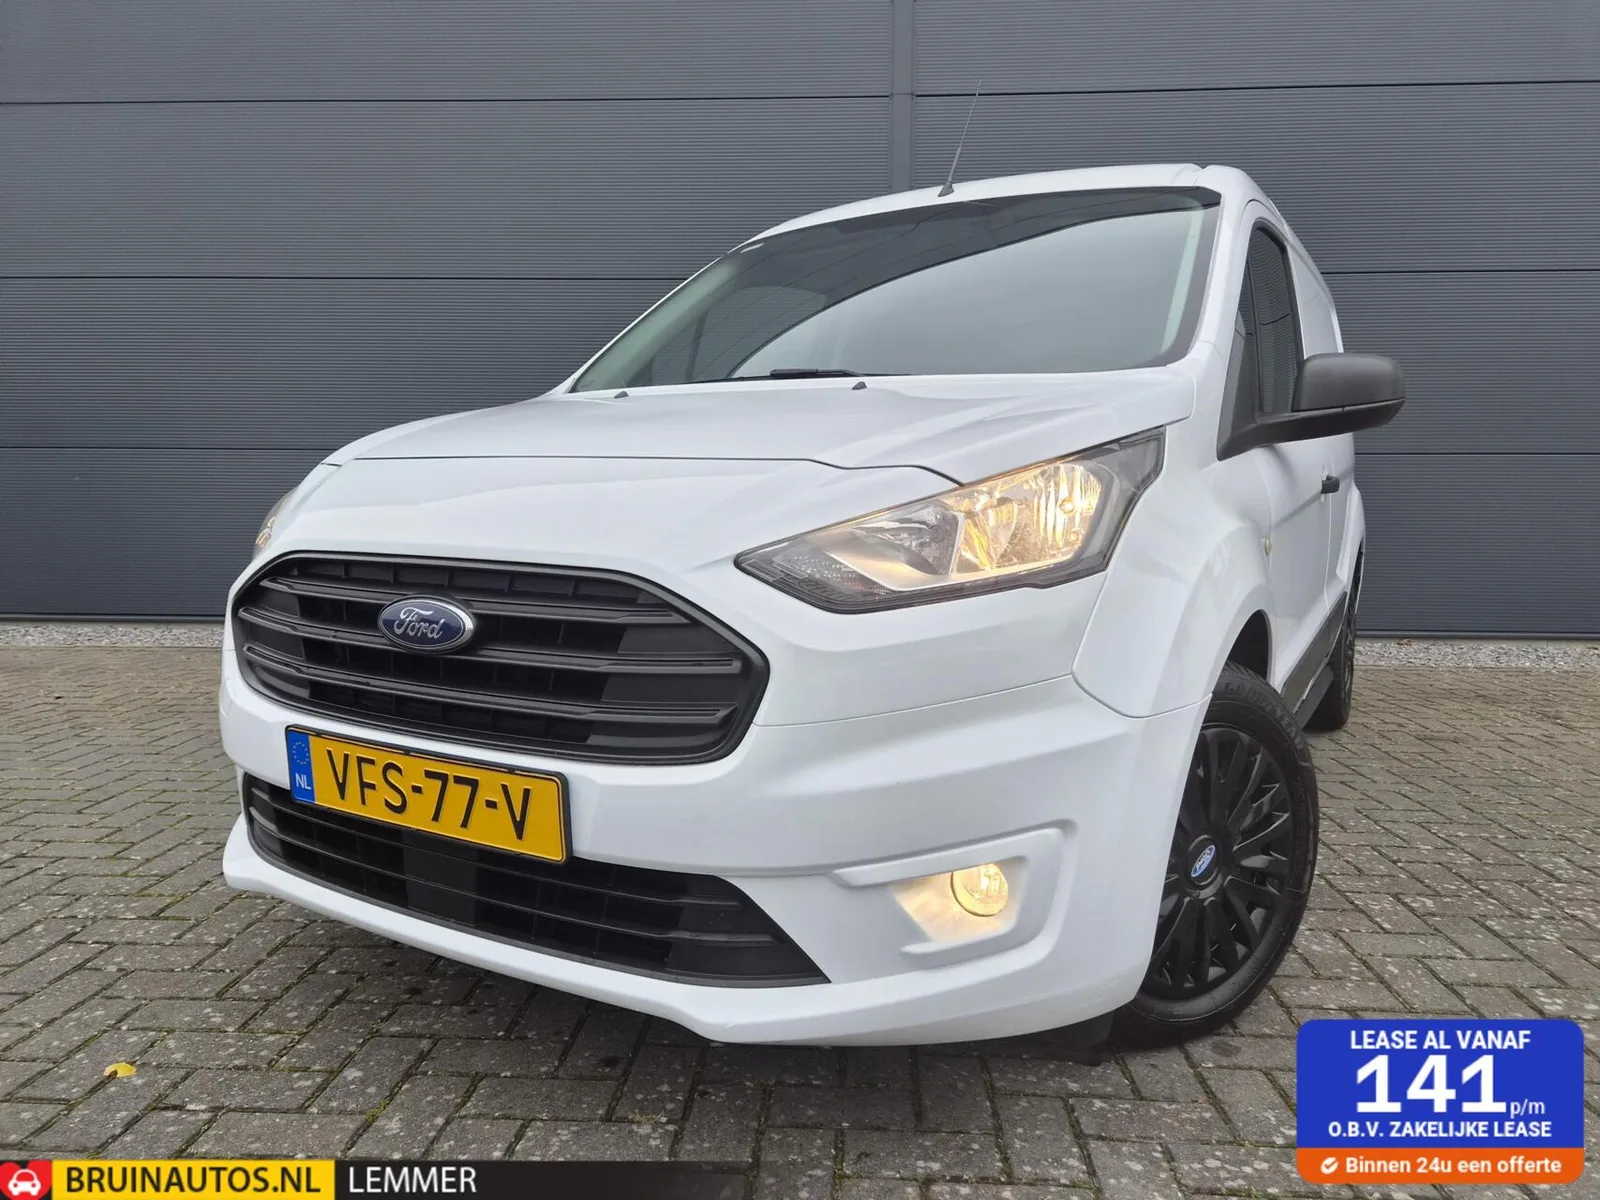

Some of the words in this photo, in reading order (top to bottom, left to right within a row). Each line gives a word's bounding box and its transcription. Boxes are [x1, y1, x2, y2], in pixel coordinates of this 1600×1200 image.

[393, 606, 445, 639] Ford
[294, 772, 312, 791] NL
[326, 747, 532, 841] VFS-77-V
